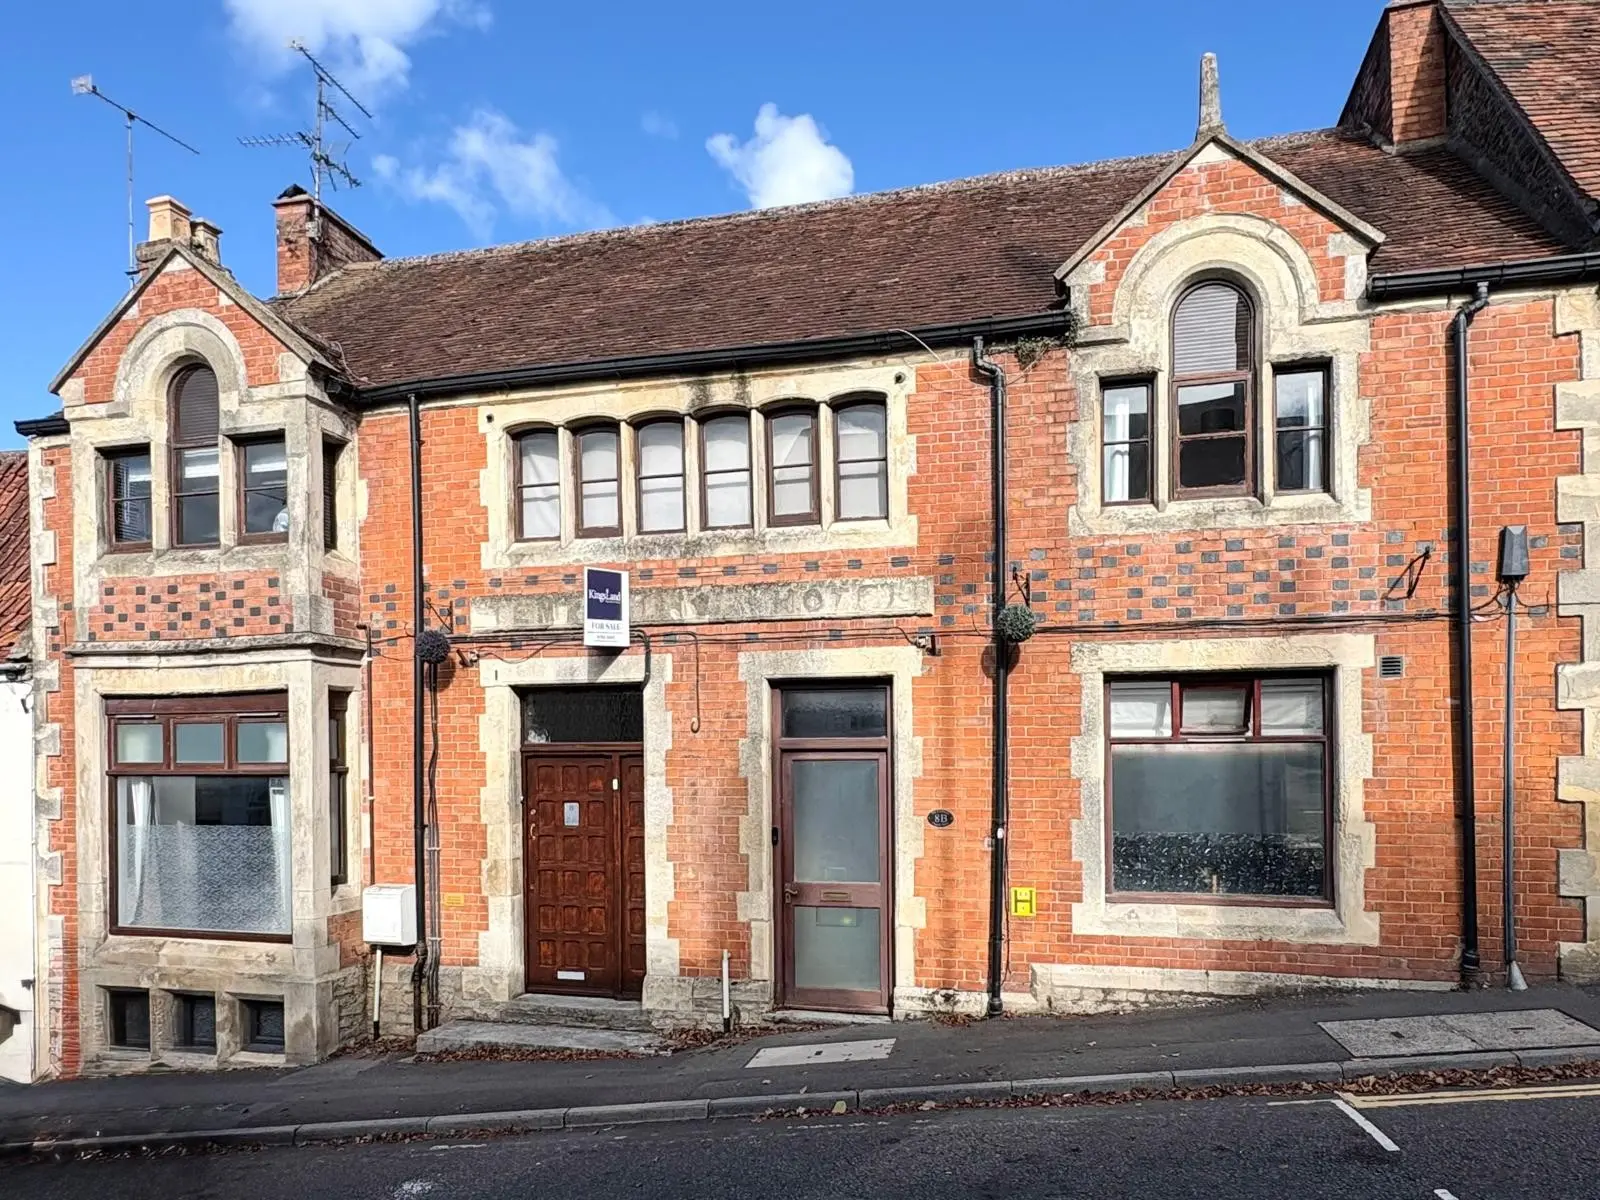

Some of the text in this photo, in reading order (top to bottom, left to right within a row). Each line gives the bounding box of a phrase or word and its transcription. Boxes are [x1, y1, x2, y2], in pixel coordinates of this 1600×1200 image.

[591, 621, 621, 631] FOR SALE
[934, 813, 948, 823] 8B
[1014, 889, 1033, 914] H
